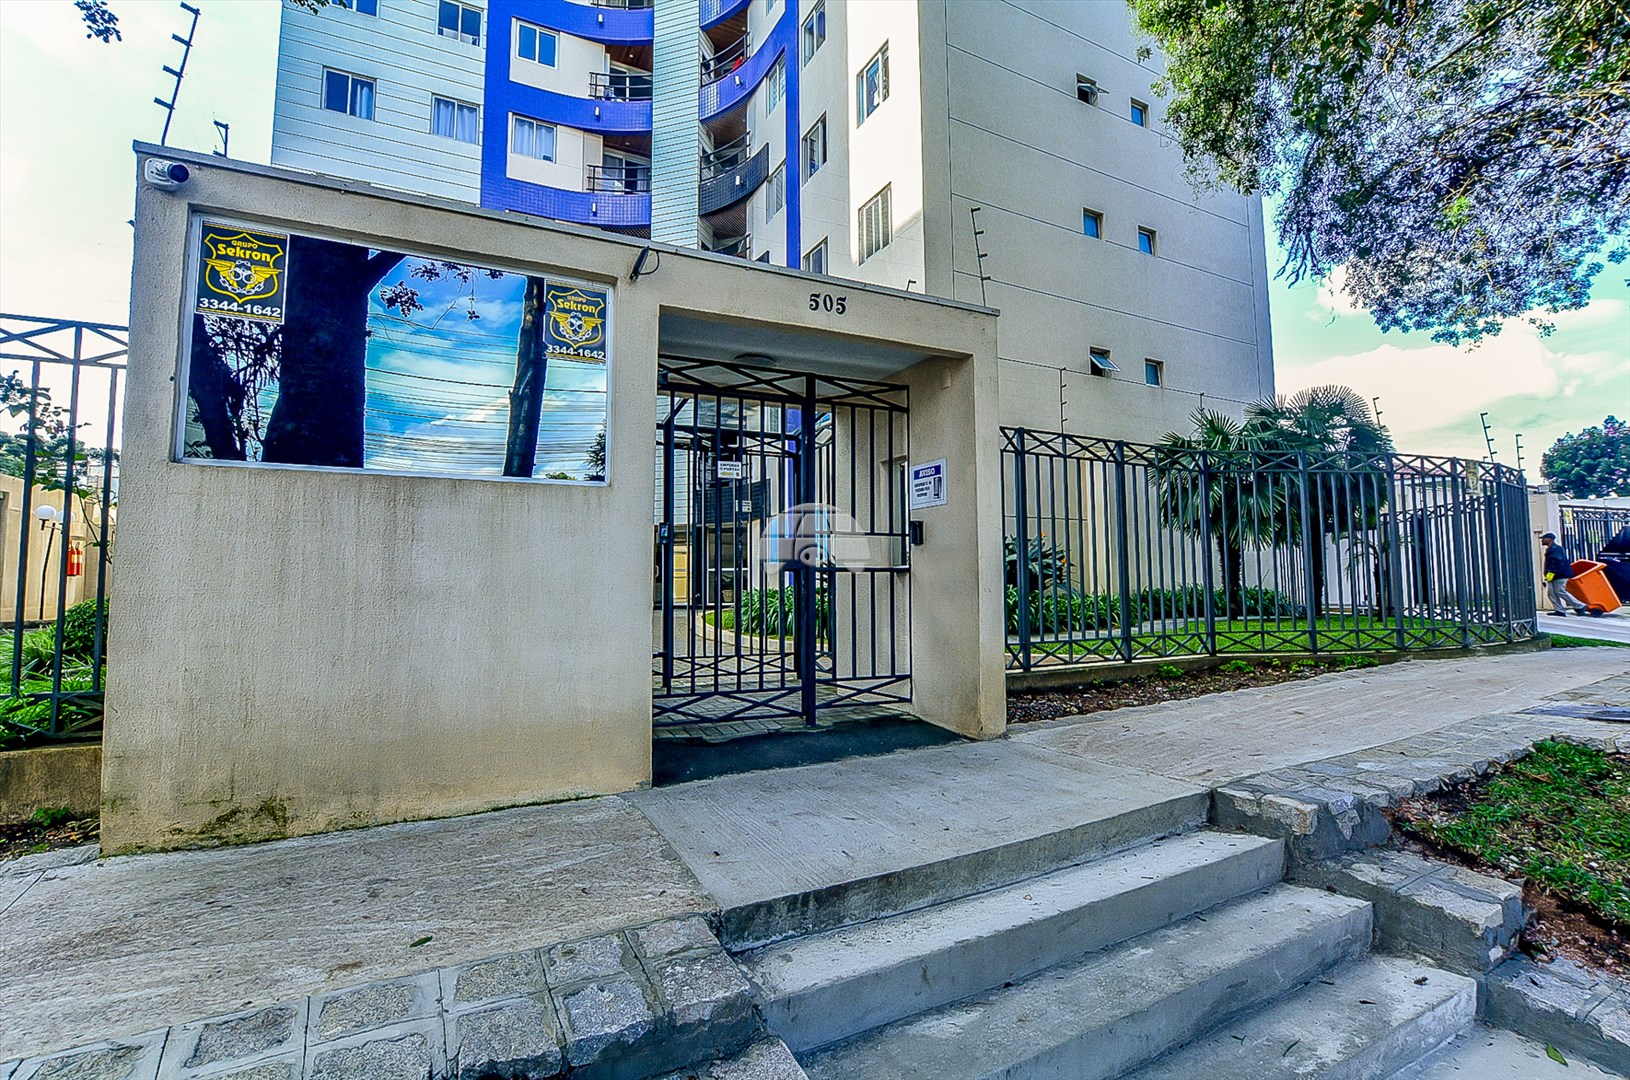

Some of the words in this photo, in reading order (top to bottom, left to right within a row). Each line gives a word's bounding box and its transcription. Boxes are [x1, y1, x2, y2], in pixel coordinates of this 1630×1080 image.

[231, 240, 258, 249] GRUPO
[217, 243, 271, 262] Sekron
[199, 298, 281, 317] 3344-1642
[557, 298, 596, 313] Sekron
[809, 293, 847, 315] 505
[546, 344, 604, 359] 3344-1642
[919, 467, 935, 477] AVISO
